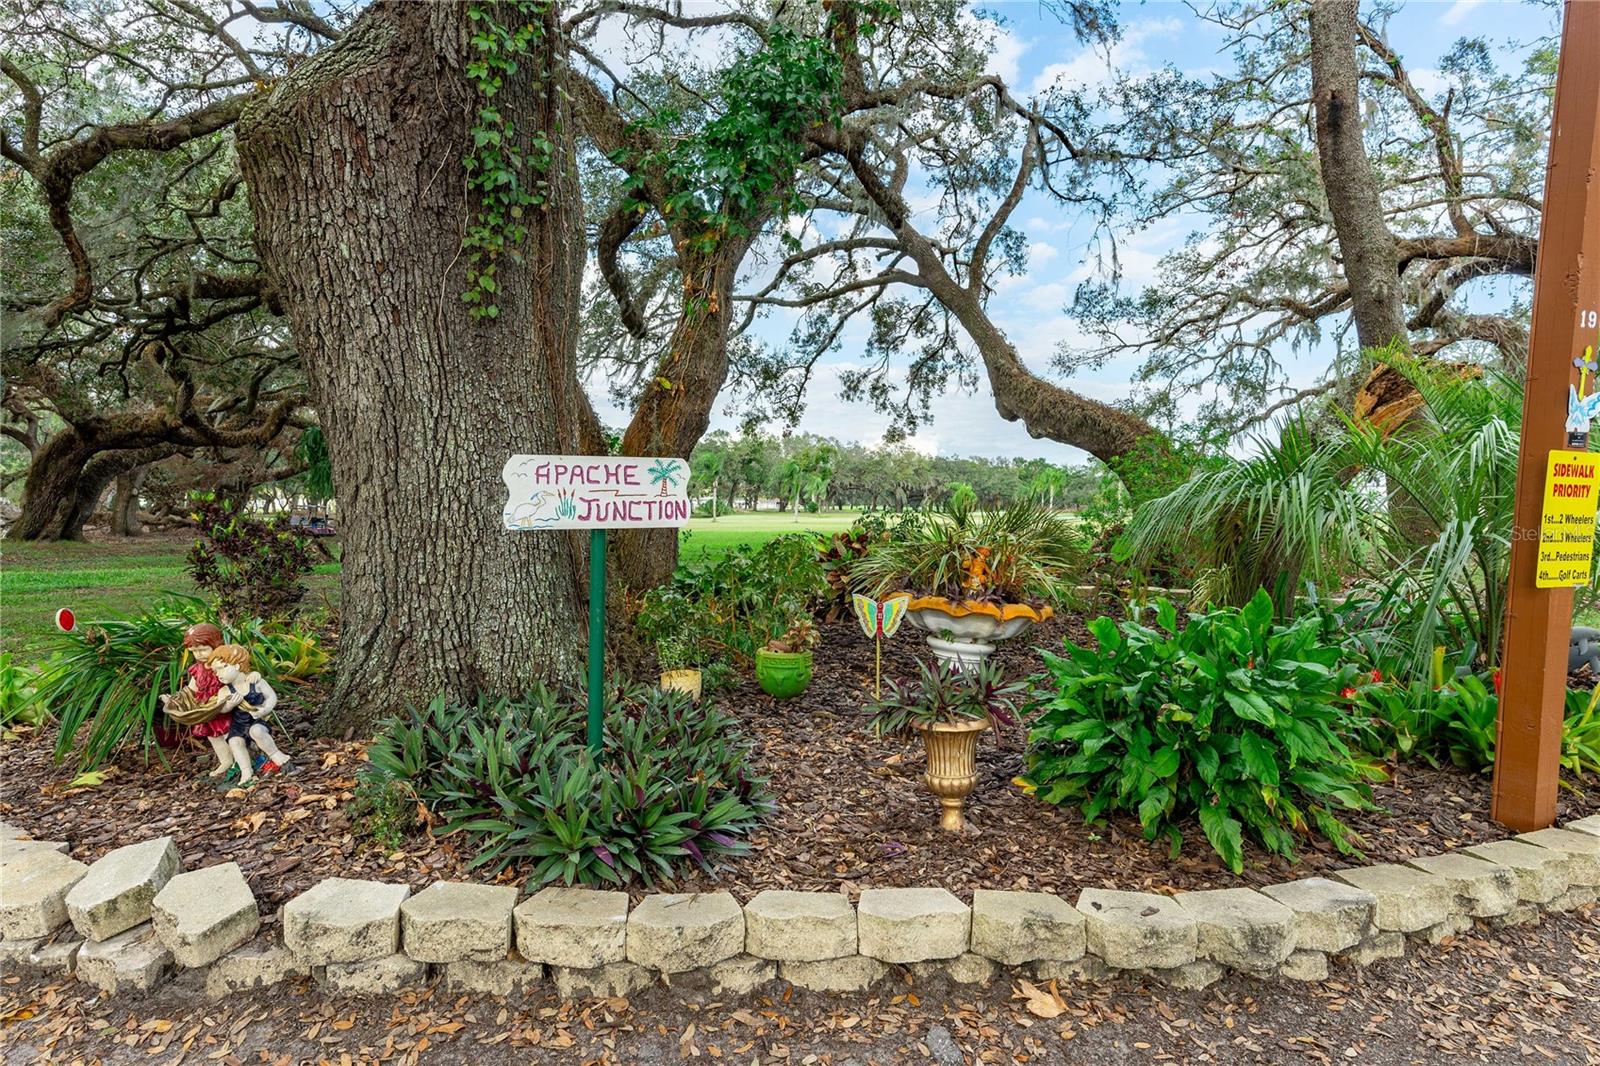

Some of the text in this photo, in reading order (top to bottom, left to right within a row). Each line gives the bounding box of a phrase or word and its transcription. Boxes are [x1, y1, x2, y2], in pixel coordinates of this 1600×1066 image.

[1580, 310, 1597, 328] 19
[535, 461, 641, 486] APACHE
[1553, 463, 1594, 478] SIDEWALK
[1553, 483, 1591, 498] PRIORITY
[578, 497, 687, 522] JUNCTION
[1565, 513, 1593, 525] Wheelers
[1565, 532, 1591, 543] Wheelers
[1572, 570, 1587, 580] Carts
